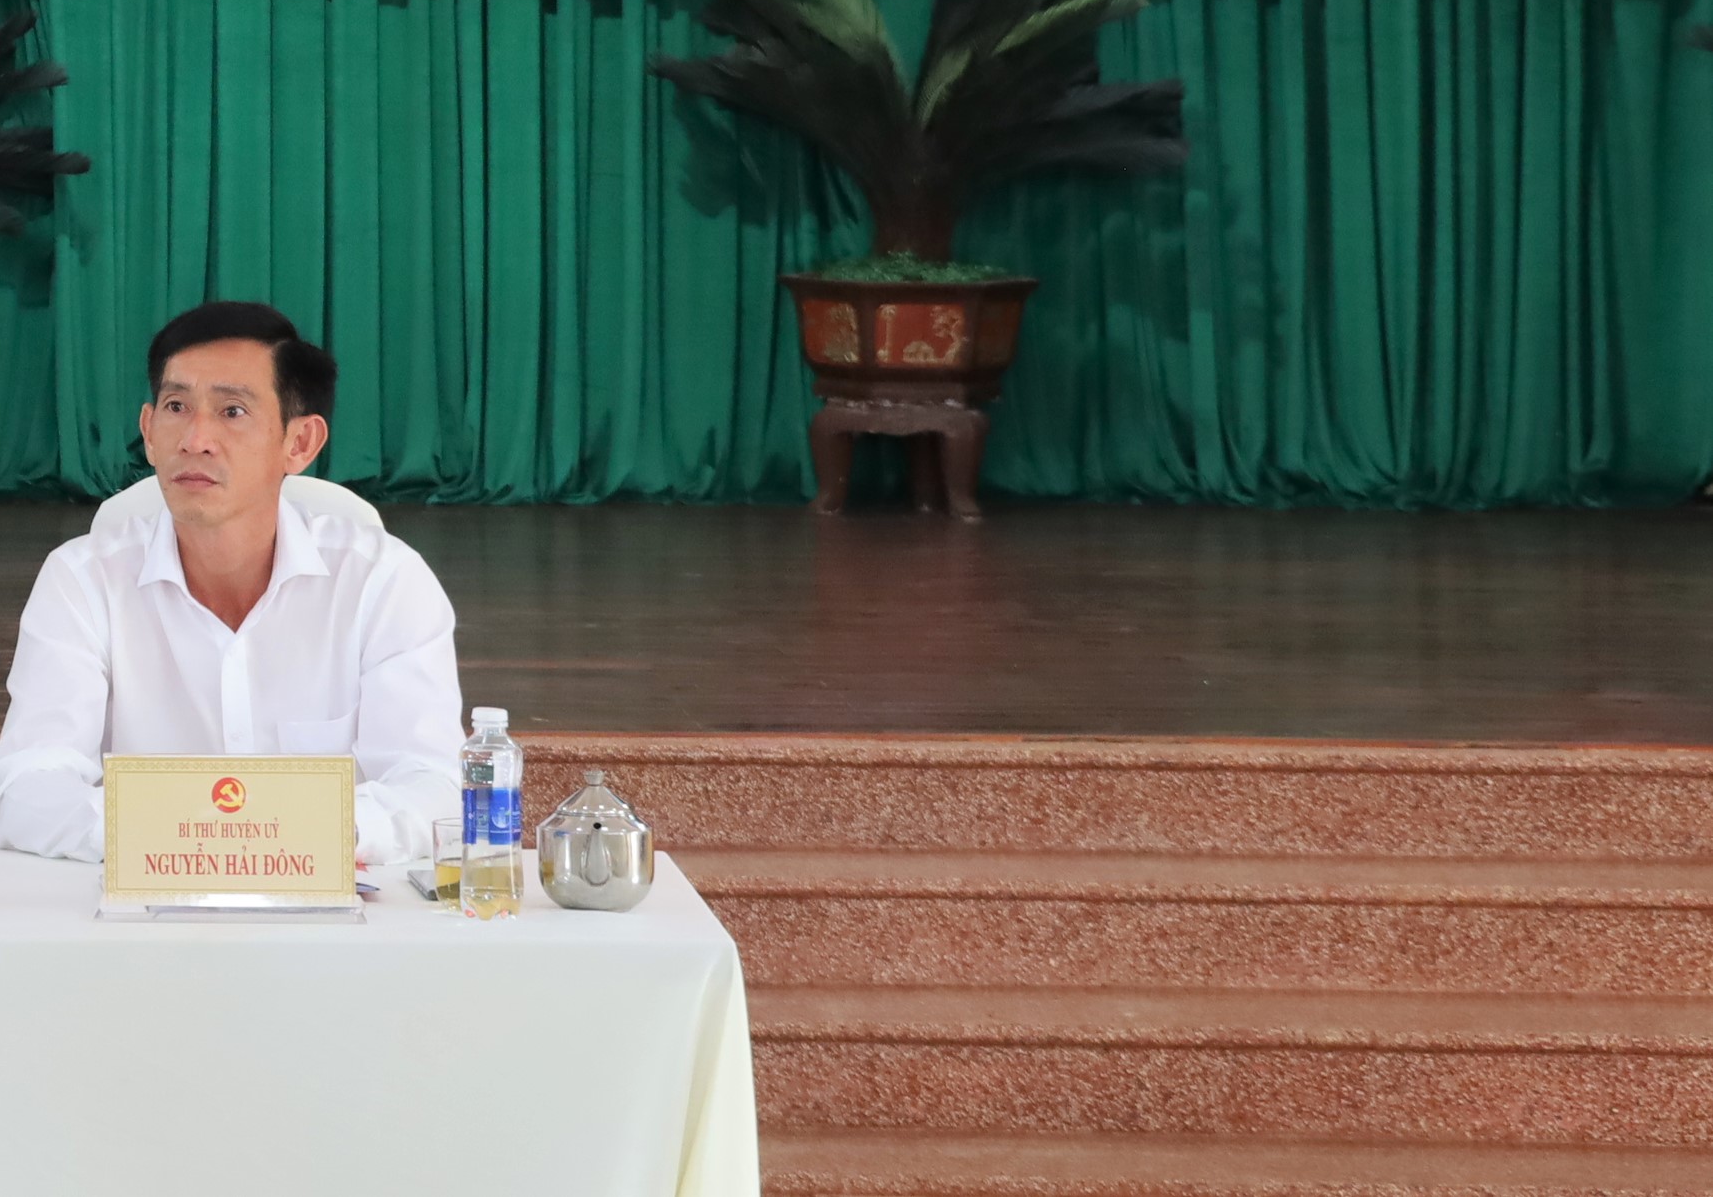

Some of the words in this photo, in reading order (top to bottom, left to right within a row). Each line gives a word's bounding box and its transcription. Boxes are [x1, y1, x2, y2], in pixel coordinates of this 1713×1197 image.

[179, 818, 190, 837] BÍ
[194, 820, 218, 838] THƯ
[221, 820, 261, 842] HUYỆN
[265, 817, 279, 838] UỶ
[145, 843, 219, 874] NGUYỄN
[225, 845, 257, 875] HẢI
[263, 848, 314, 876] ĐÔNG
